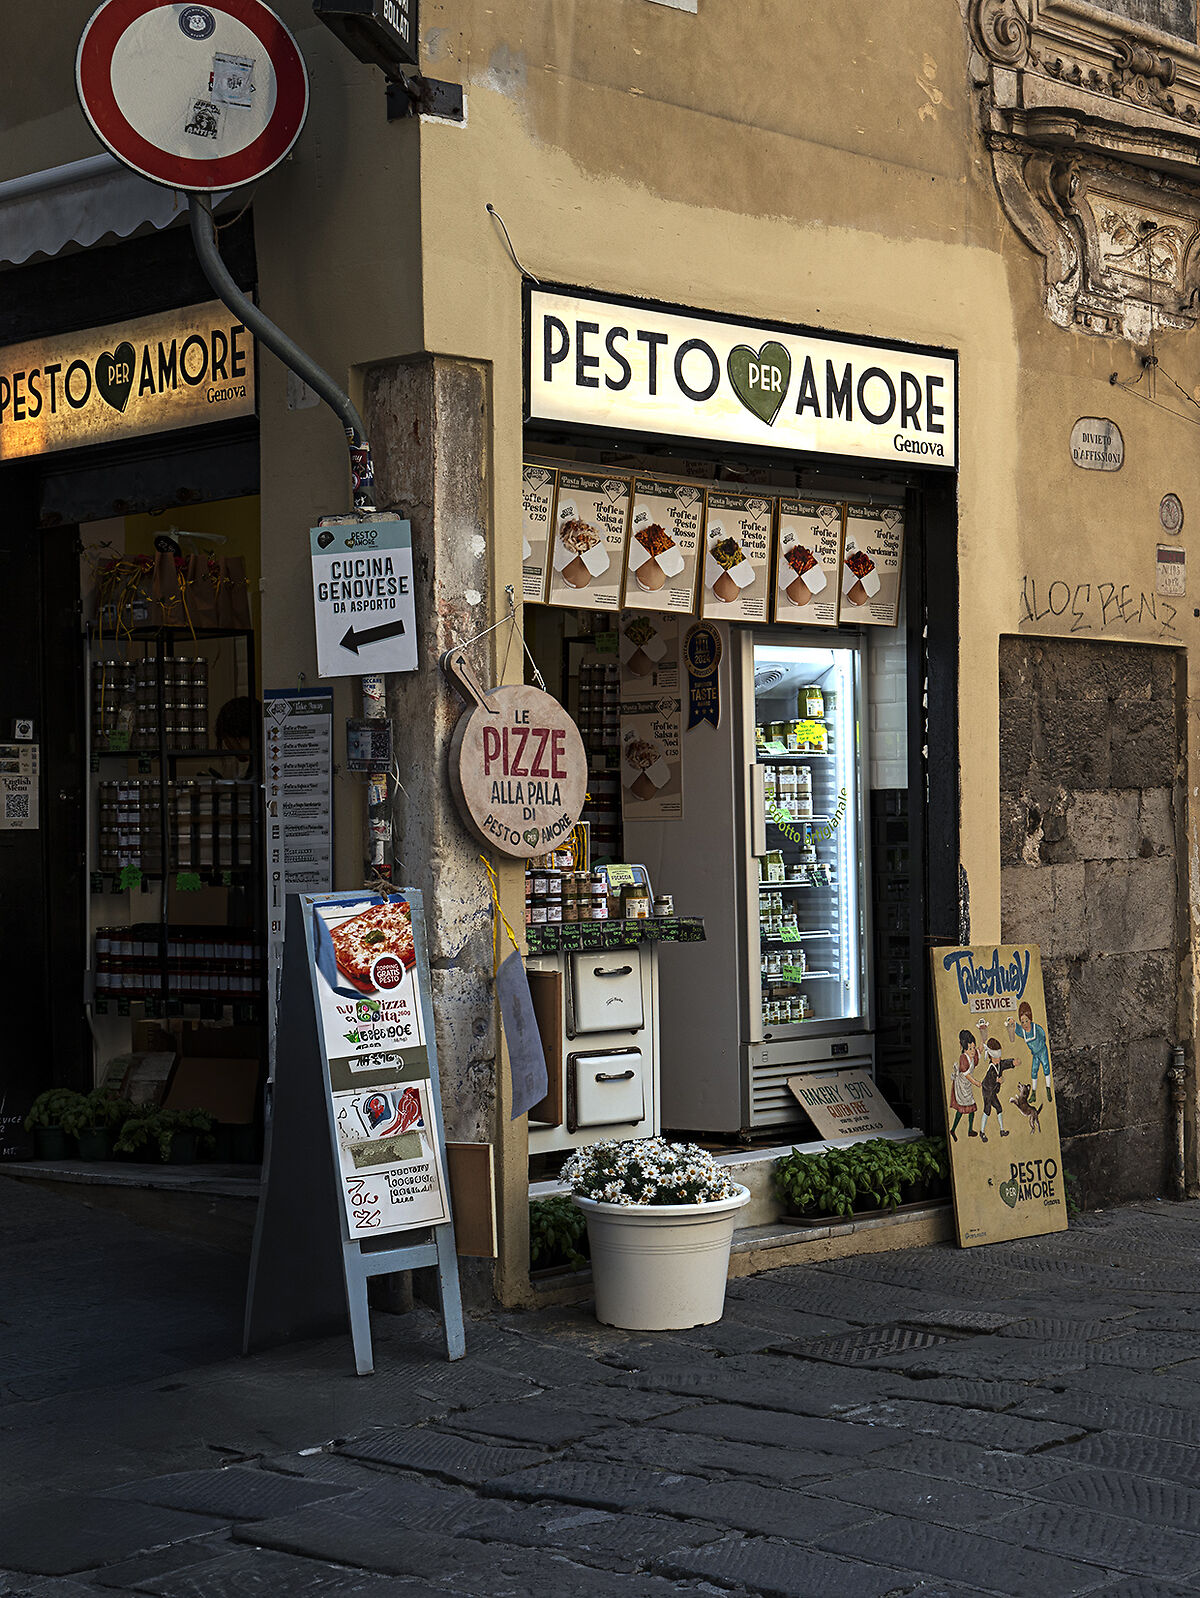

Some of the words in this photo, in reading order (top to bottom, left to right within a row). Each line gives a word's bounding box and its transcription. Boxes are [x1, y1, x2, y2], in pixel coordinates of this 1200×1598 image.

[0, 359, 92, 425] PESTO
[107, 364, 130, 387] PER
[138, 325, 247, 399] AMORE
[543, 314, 721, 402] PESTO
[748, 361, 782, 393] PER
[795, 355, 945, 434] AMORE
[206, 383, 247, 405] Genova
[893, 434, 945, 457] Genova
[1082, 432, 1112, 446] DIVIETO
[1073, 446, 1121, 465] D'AFFISSIONI
[522, 502, 547, 513] Pesto
[593, 502, 618, 515] Trofie
[667, 507, 691, 519] Trofie
[596, 513, 617, 523] Salsa
[674, 518, 697, 529] Pesto
[605, 523, 623, 533] Noci
[738, 519, 761, 531] Trofie
[810, 525, 832, 537] Trofie
[351, 530, 378, 540] PESTO
[672, 527, 696, 538] Rosso
[742, 530, 762, 540] Pesto
[874, 529, 894, 540] Trofie
[741, 539, 766, 549] Tartufo
[821, 538, 837, 548] Sugo
[883, 540, 898, 551] Sugo
[815, 545, 837, 556] Ligure
[331, 557, 394, 579] CUCINA
[318, 576, 409, 601] GENOVESE
[333, 602, 346, 614] DA
[350, 598, 396, 613] ASPORTO
[690, 688, 717, 701] TASTE
[515, 710, 530, 724] LE
[650, 721, 673, 730] Trofie
[654, 730, 672, 739] Salsa
[482, 726, 567, 779] PIZZE
[3, 777, 31, 787] English
[491, 781, 525, 805] ALLA
[527, 781, 561, 806] PALA
[523, 807, 536, 821] DI
[765, 786, 801, 843] Prodotto
[805, 787, 847, 845] artigianale
[483, 814, 521, 845] PESTO
[541, 813, 573, 844] AMORE
[376, 963, 399, 972] TOPPING
[376, 969, 401, 979] GRATIS
[379, 976, 399, 984] PESTO
[943, 950, 988, 1005] Take
[985, 948, 1030, 1000] Away
[975, 998, 1011, 1011] SERVICE
[800, 1085, 844, 1106] BAKERY
[844, 1081, 873, 1100] 1970
[826, 1103, 852, 1118] GLUTEN
[850, 1101, 869, 1115] FREE
[847, 1124, 876, 1133] RAVECCA
[1010, 1158, 1058, 1183] PESTO
[1005, 1187, 1016, 1197] PER
[1018, 1180, 1055, 1201] AMORE
